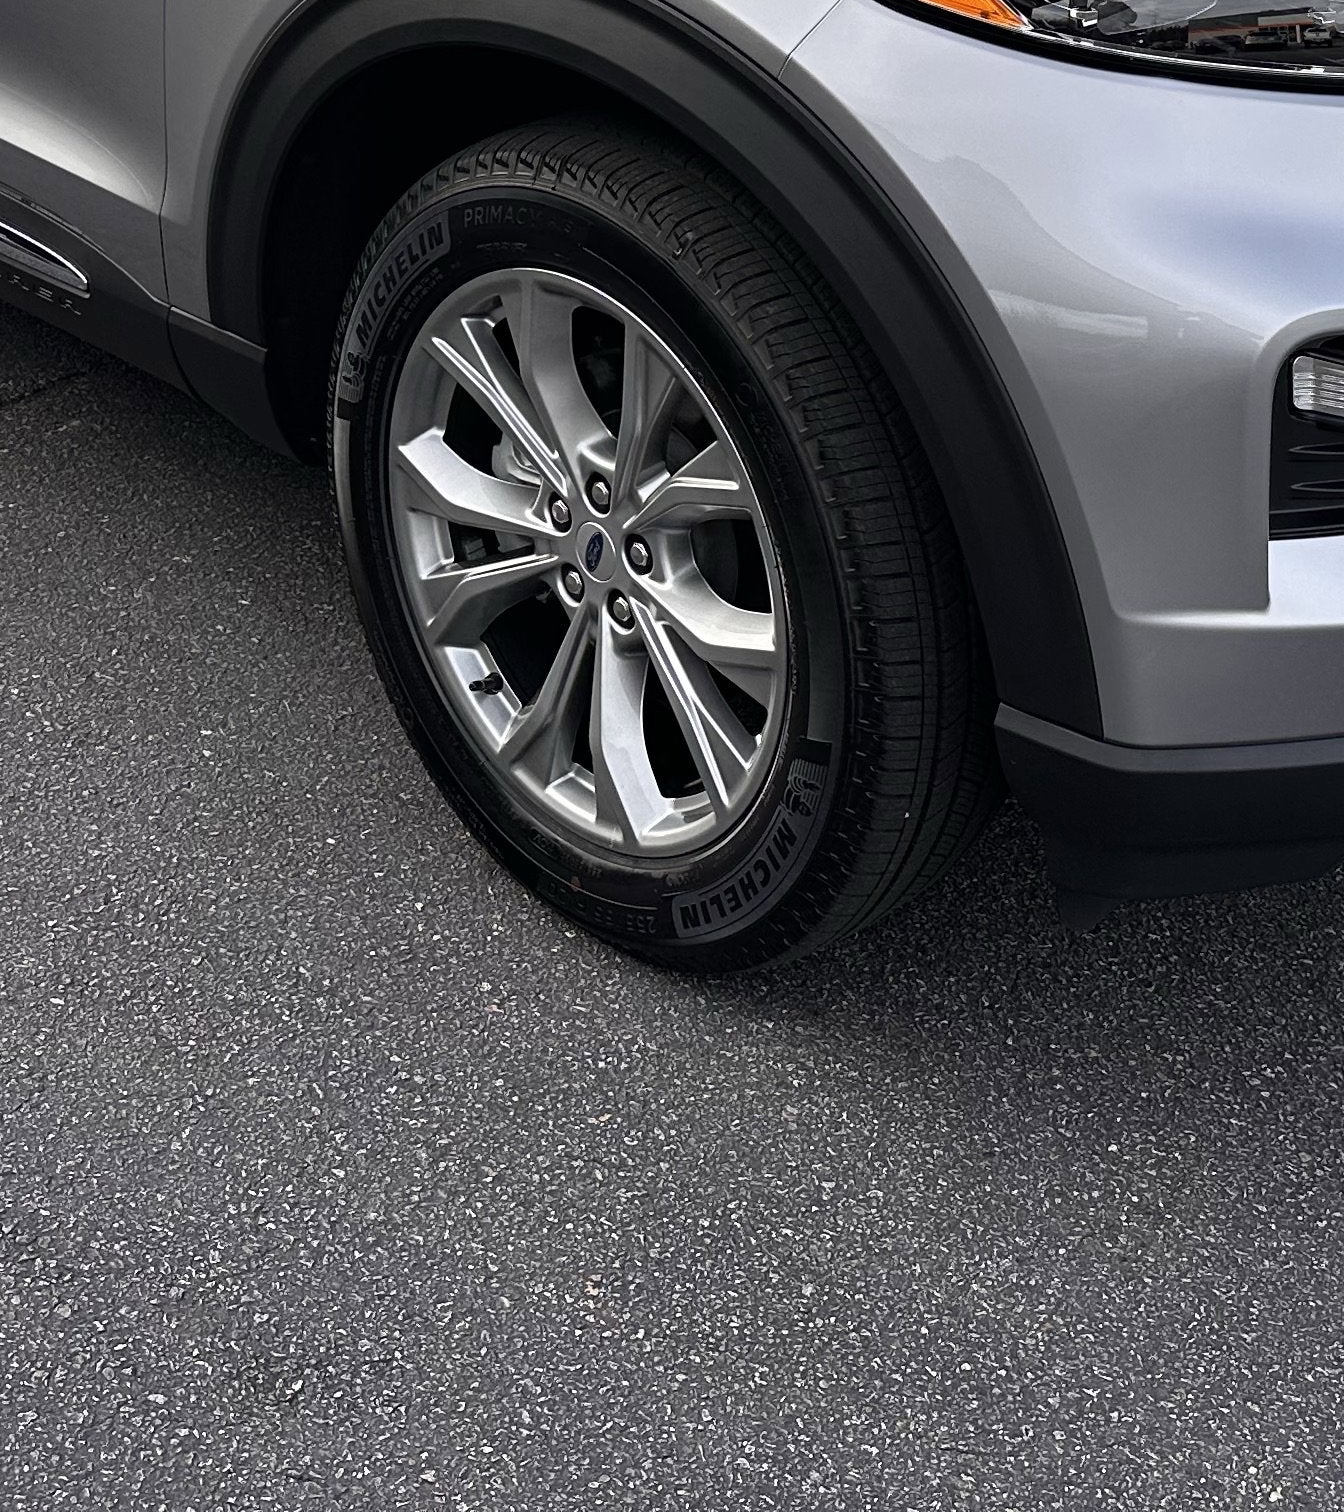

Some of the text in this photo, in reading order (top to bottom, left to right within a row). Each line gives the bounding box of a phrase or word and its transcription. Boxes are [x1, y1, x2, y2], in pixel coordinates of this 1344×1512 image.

[463, 204, 544, 228] PRIMACY
[355, 221, 445, 350] MICHELIN
[678, 817, 798, 931] MICHELIN
